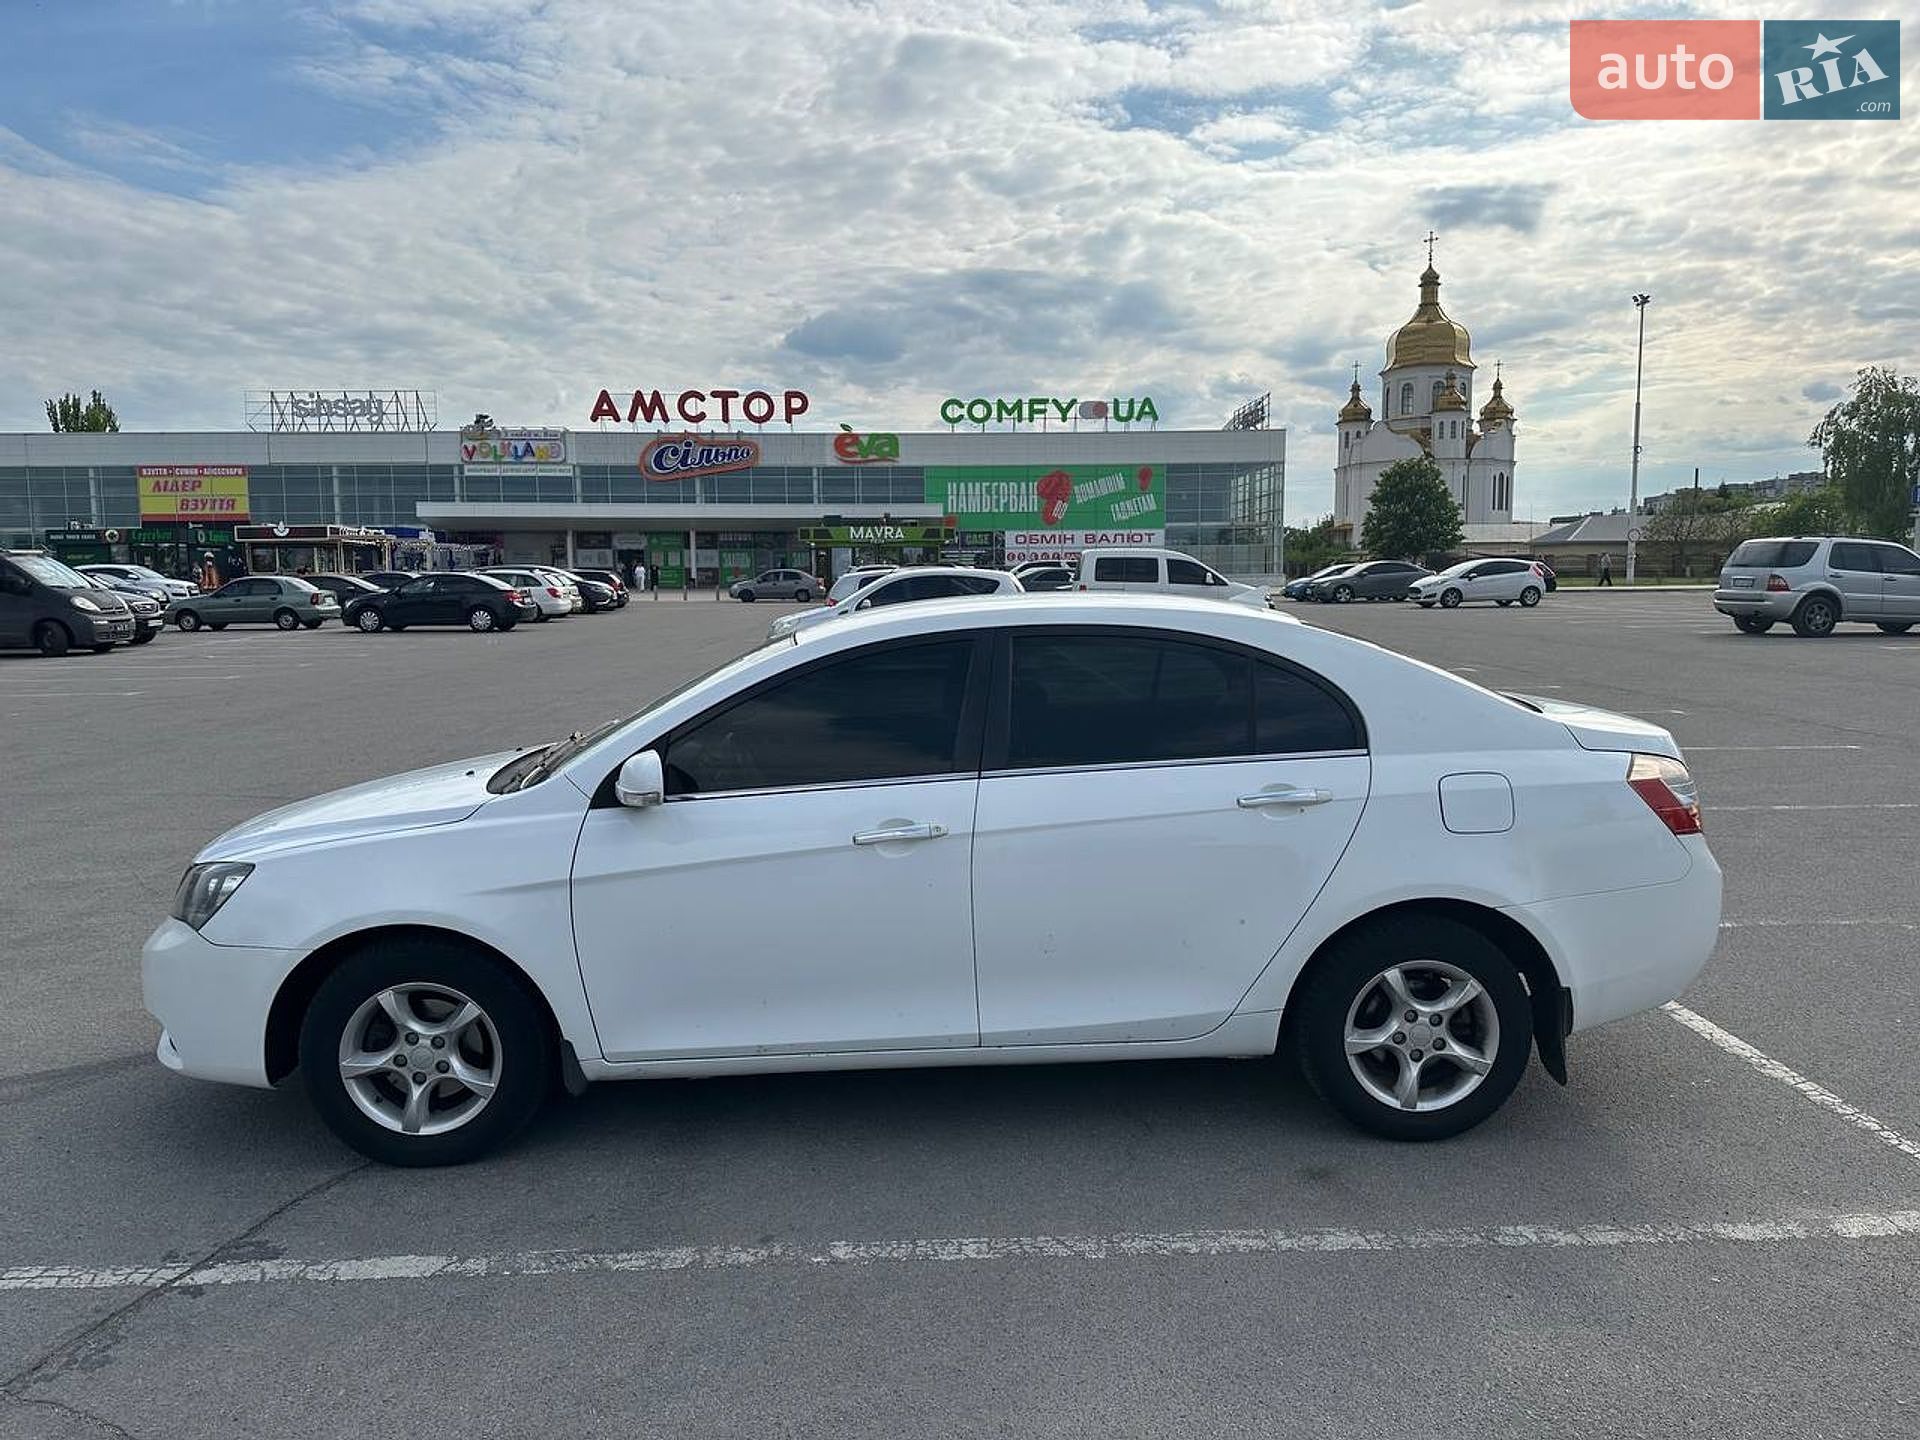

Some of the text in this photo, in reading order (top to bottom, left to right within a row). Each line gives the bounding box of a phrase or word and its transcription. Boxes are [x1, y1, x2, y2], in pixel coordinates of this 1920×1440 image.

[293, 392, 383, 424] sinsay
[590, 389, 809, 424] АМСТОР
[940, 397, 1159, 424] COMFY UA
[652, 439, 751, 474] Сільпо
[152, 480, 202, 492] ЛІДЕР
[947, 481, 1039, 513] НАМБЕРВАН
[179, 498, 236, 511] ВЗУТТЯ
[850, 526, 904, 540] MAVRA
[1015, 532, 1156, 545] ОБМІН ВАЛЮТ
